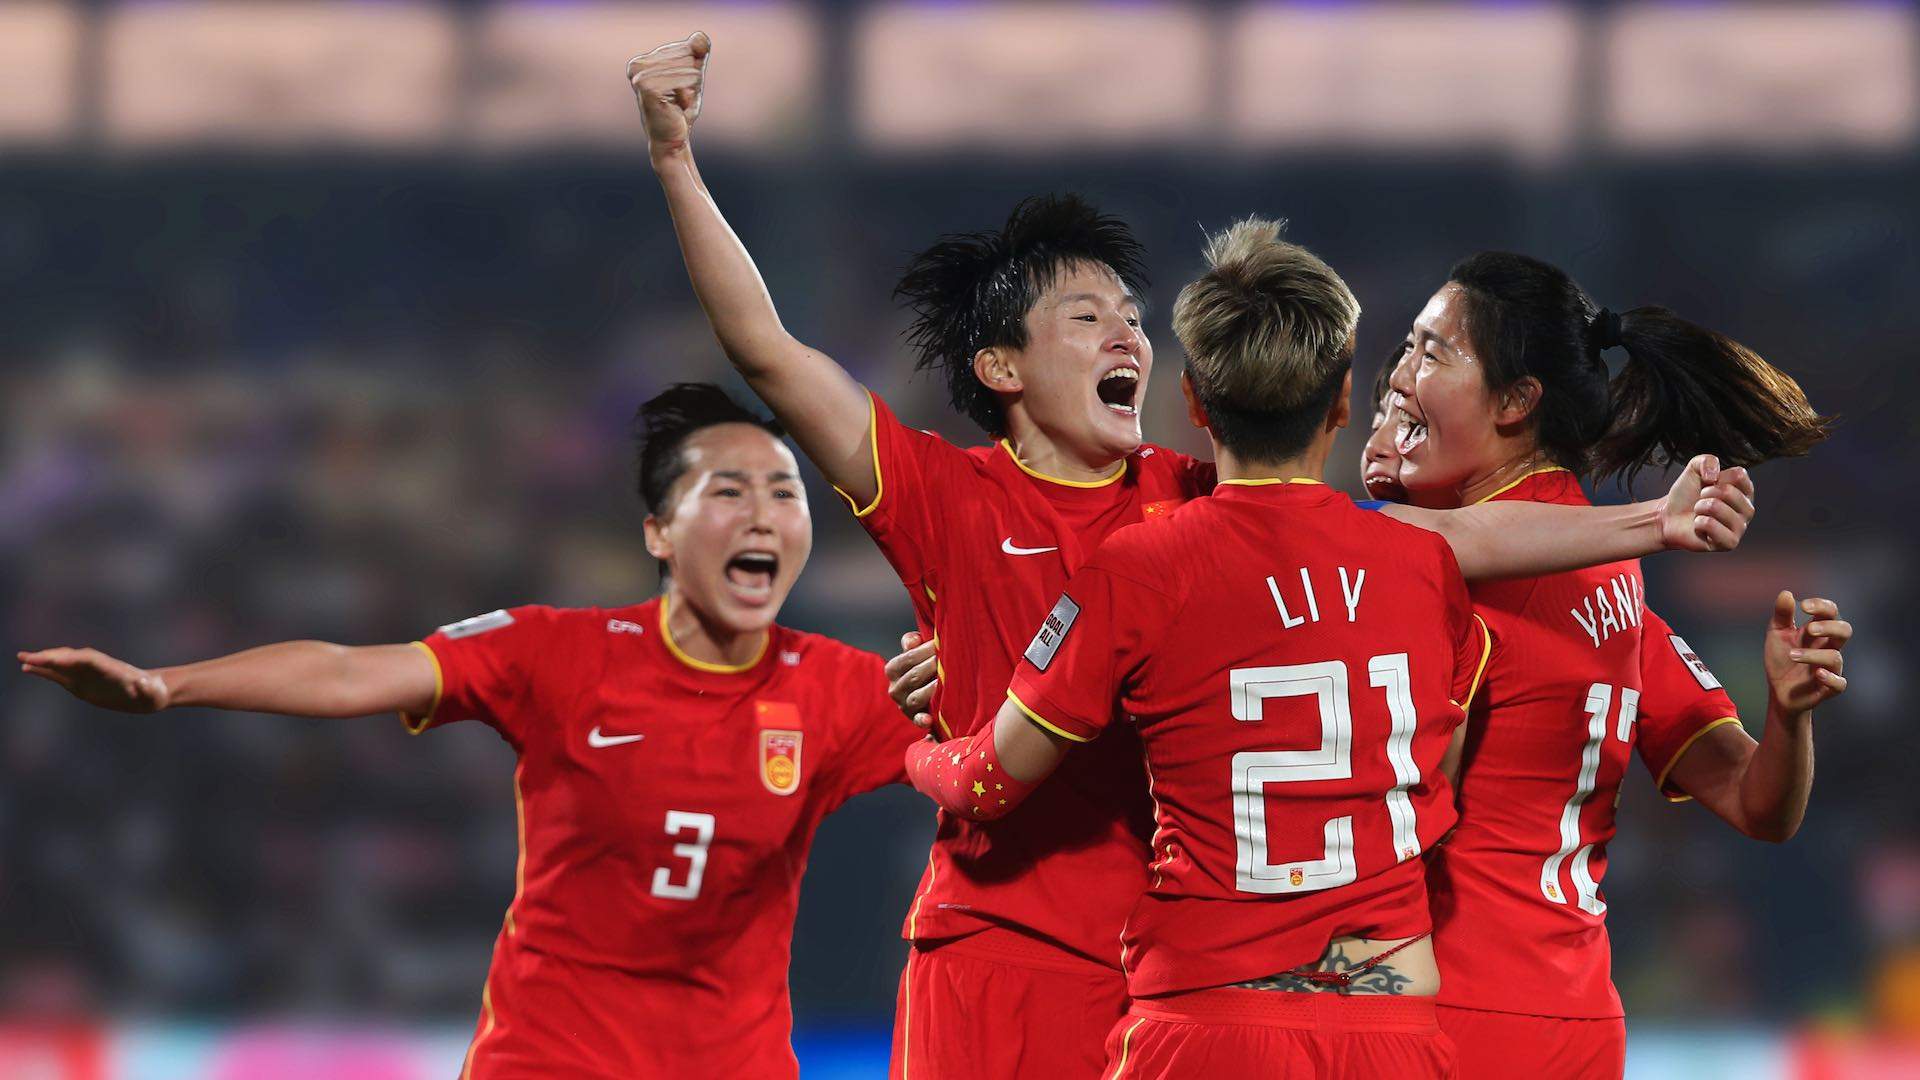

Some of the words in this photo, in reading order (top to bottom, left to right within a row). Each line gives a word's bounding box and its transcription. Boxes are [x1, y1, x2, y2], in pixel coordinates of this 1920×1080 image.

[1266, 567, 1320, 629] LI
[1338, 566, 1366, 622] Y
[1229, 652, 1422, 895] 21
[651, 809, 716, 901] 3
